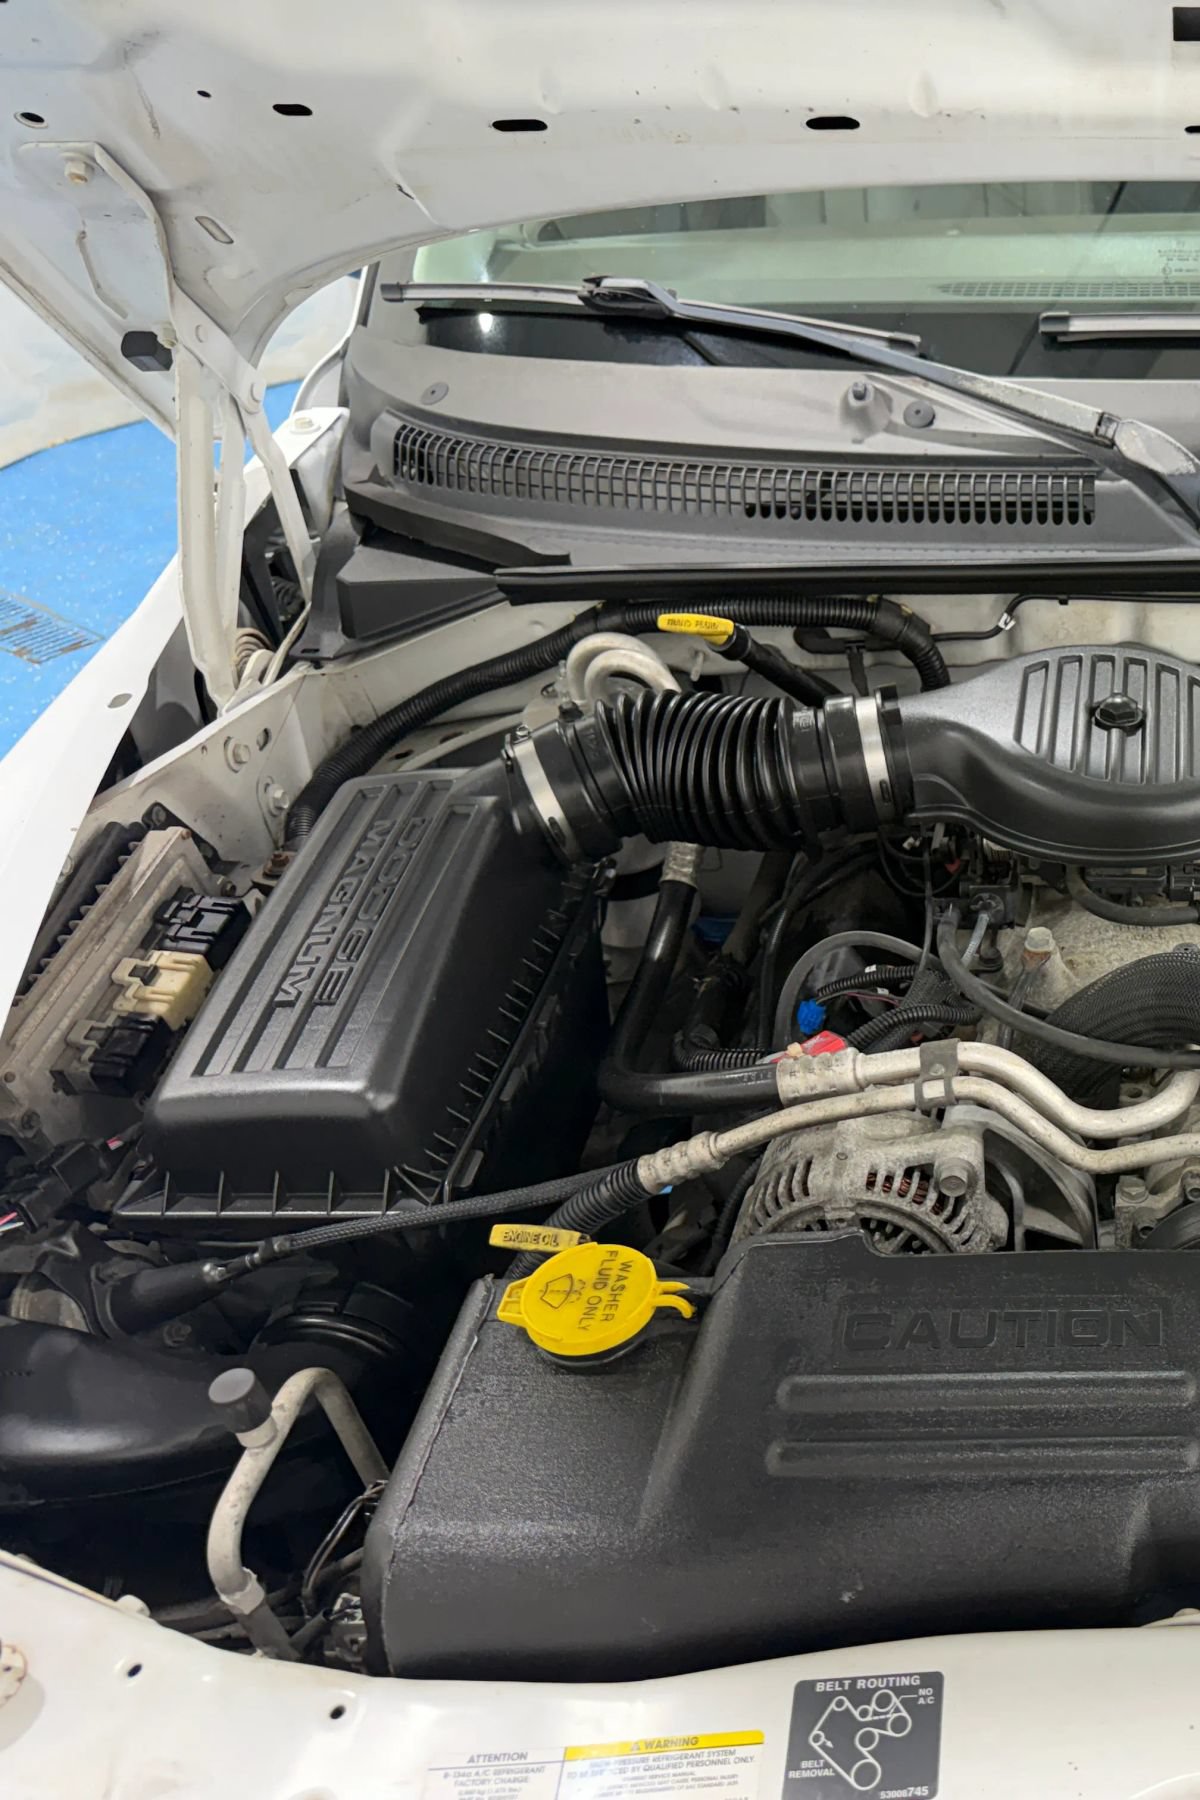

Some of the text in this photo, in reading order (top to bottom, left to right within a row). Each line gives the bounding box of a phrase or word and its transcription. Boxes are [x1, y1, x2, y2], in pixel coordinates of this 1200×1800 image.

[272, 818, 396, 1008] MAGNUM
[313, 816, 432, 1006] DODGE
[503, 1230, 541, 1245] ENGINE
[577, 1249, 620, 1332] FLUID ONLY
[600, 1259, 635, 1323] WASHER
[842, 1310, 1163, 1349] CAUTION
[815, 1675, 921, 1692] BELT ROUTING
[918, 1687, 934, 1696] NO
[917, 1697, 935, 1705] A/C
[644, 1736, 700, 1750] WARNING
[467, 1751, 529, 1764] ATTENTION
[652, 1751, 705, 1763] REFRIGERANT
[705, 1748, 737, 1759] SYSTEM
[643, 1761, 685, 1772] QUALIFIED
[686, 1757, 732, 1769] PERSONNEL
[801, 1759, 826, 1769] BELT
[788, 1768, 836, 1779] REMOVAL
